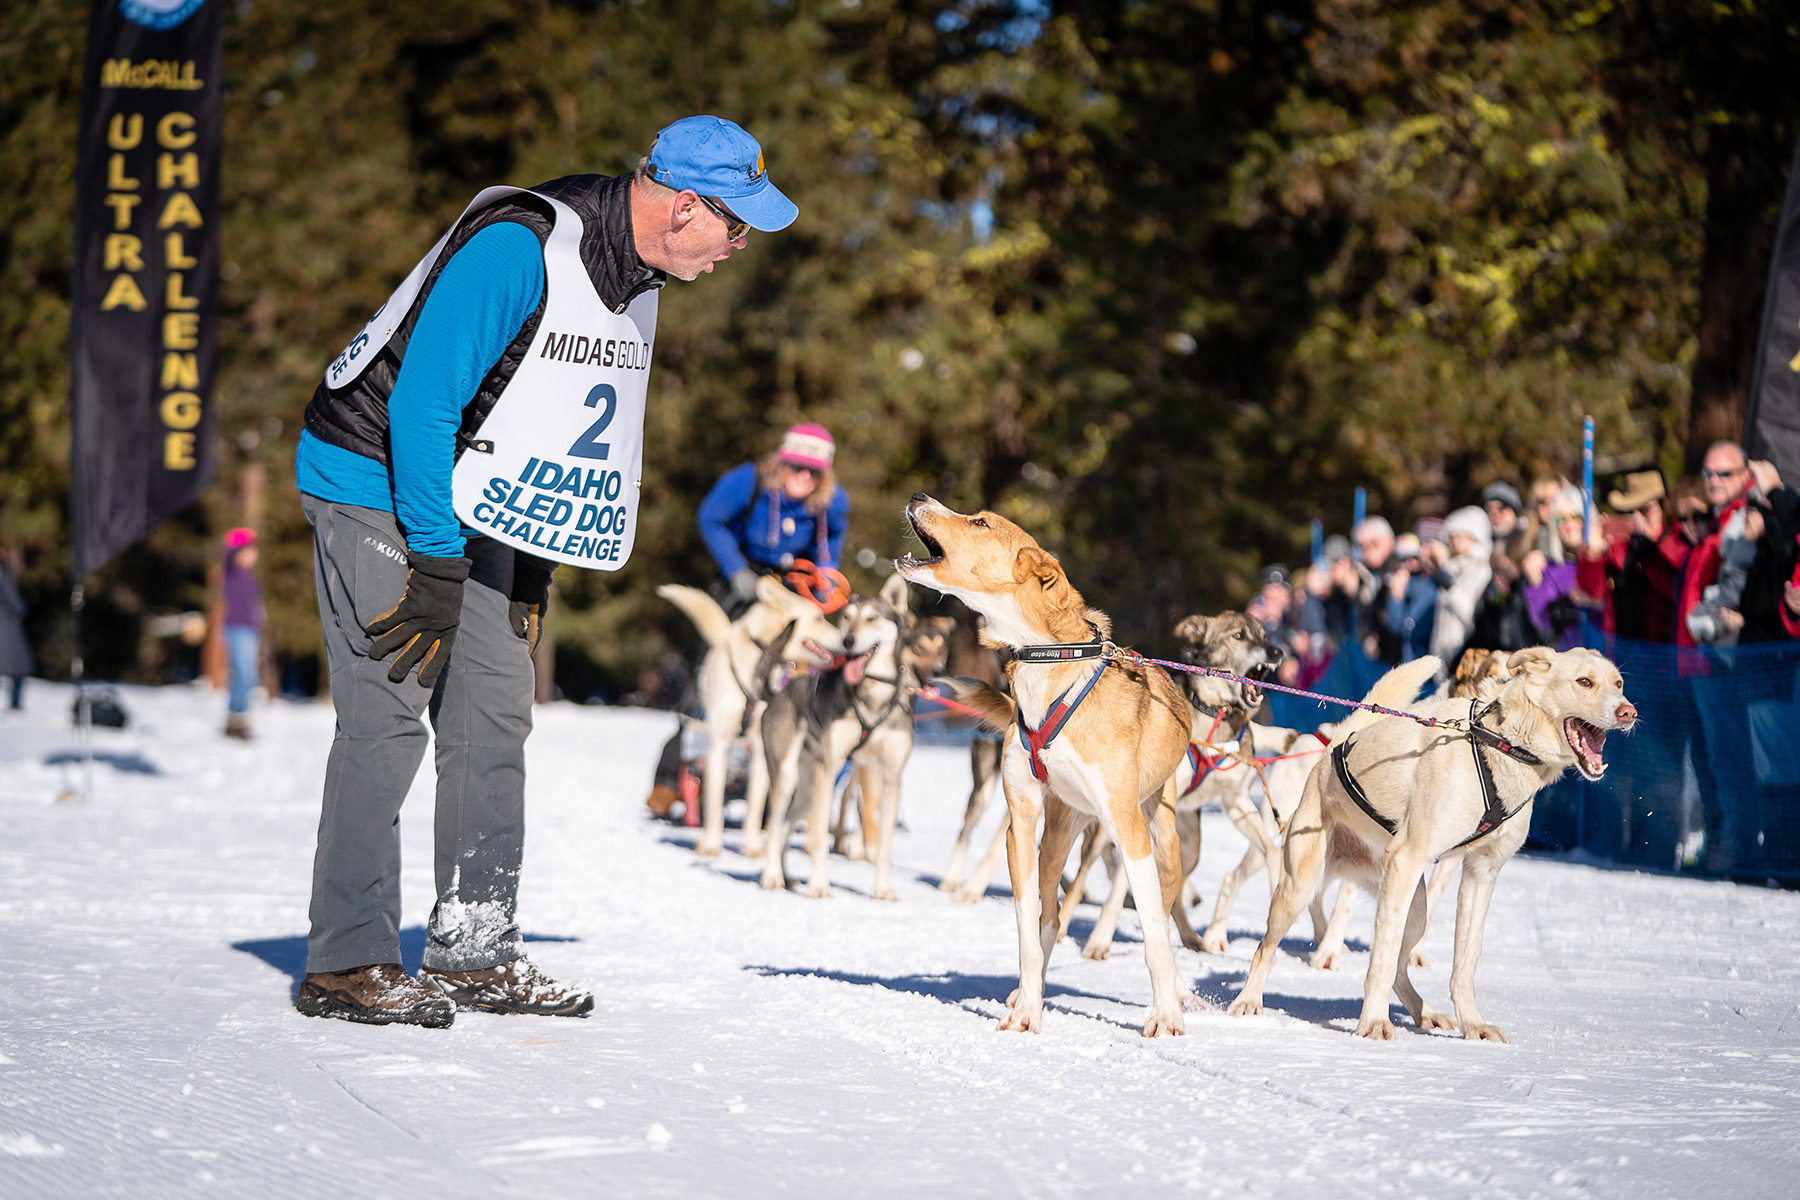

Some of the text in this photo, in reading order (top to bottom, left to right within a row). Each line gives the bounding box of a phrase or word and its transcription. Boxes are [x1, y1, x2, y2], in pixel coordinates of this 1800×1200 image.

[100, 113, 148, 312] ULTRA
[156, 111, 204, 471] CHALLENGE
[567, 383, 617, 461] 2
[483, 477, 627, 536] SLED DOG
[518, 457, 622, 501] IDAHO
[473, 502, 622, 561] CHALLENGE
